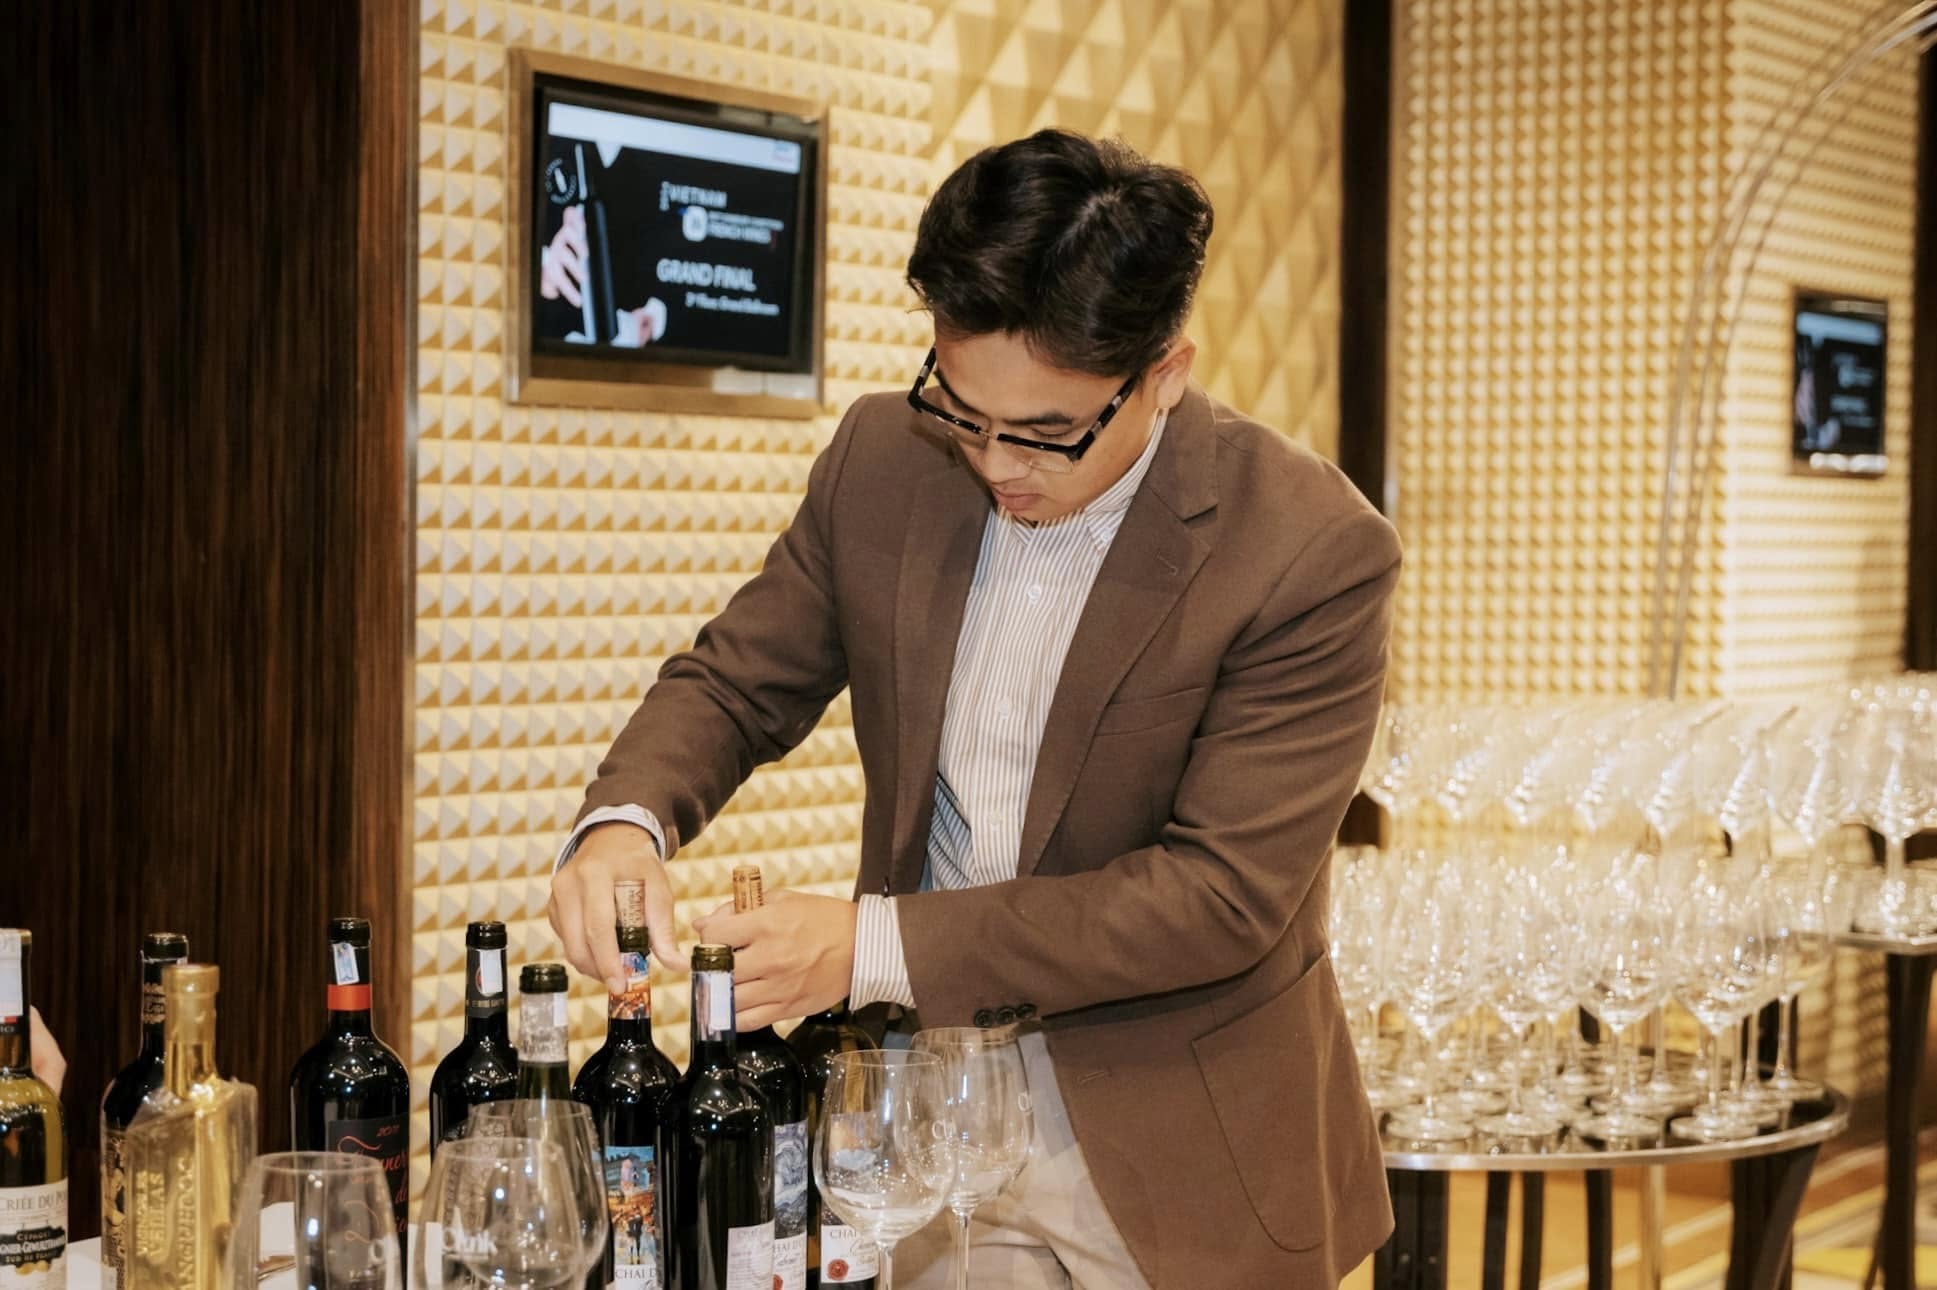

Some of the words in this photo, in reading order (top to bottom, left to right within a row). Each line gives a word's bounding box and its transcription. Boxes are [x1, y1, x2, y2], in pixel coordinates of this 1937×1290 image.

[656, 258, 713, 287] GRAND
[713, 264, 757, 293] FINAL
[148, 1172, 165, 1258] VELLAS
